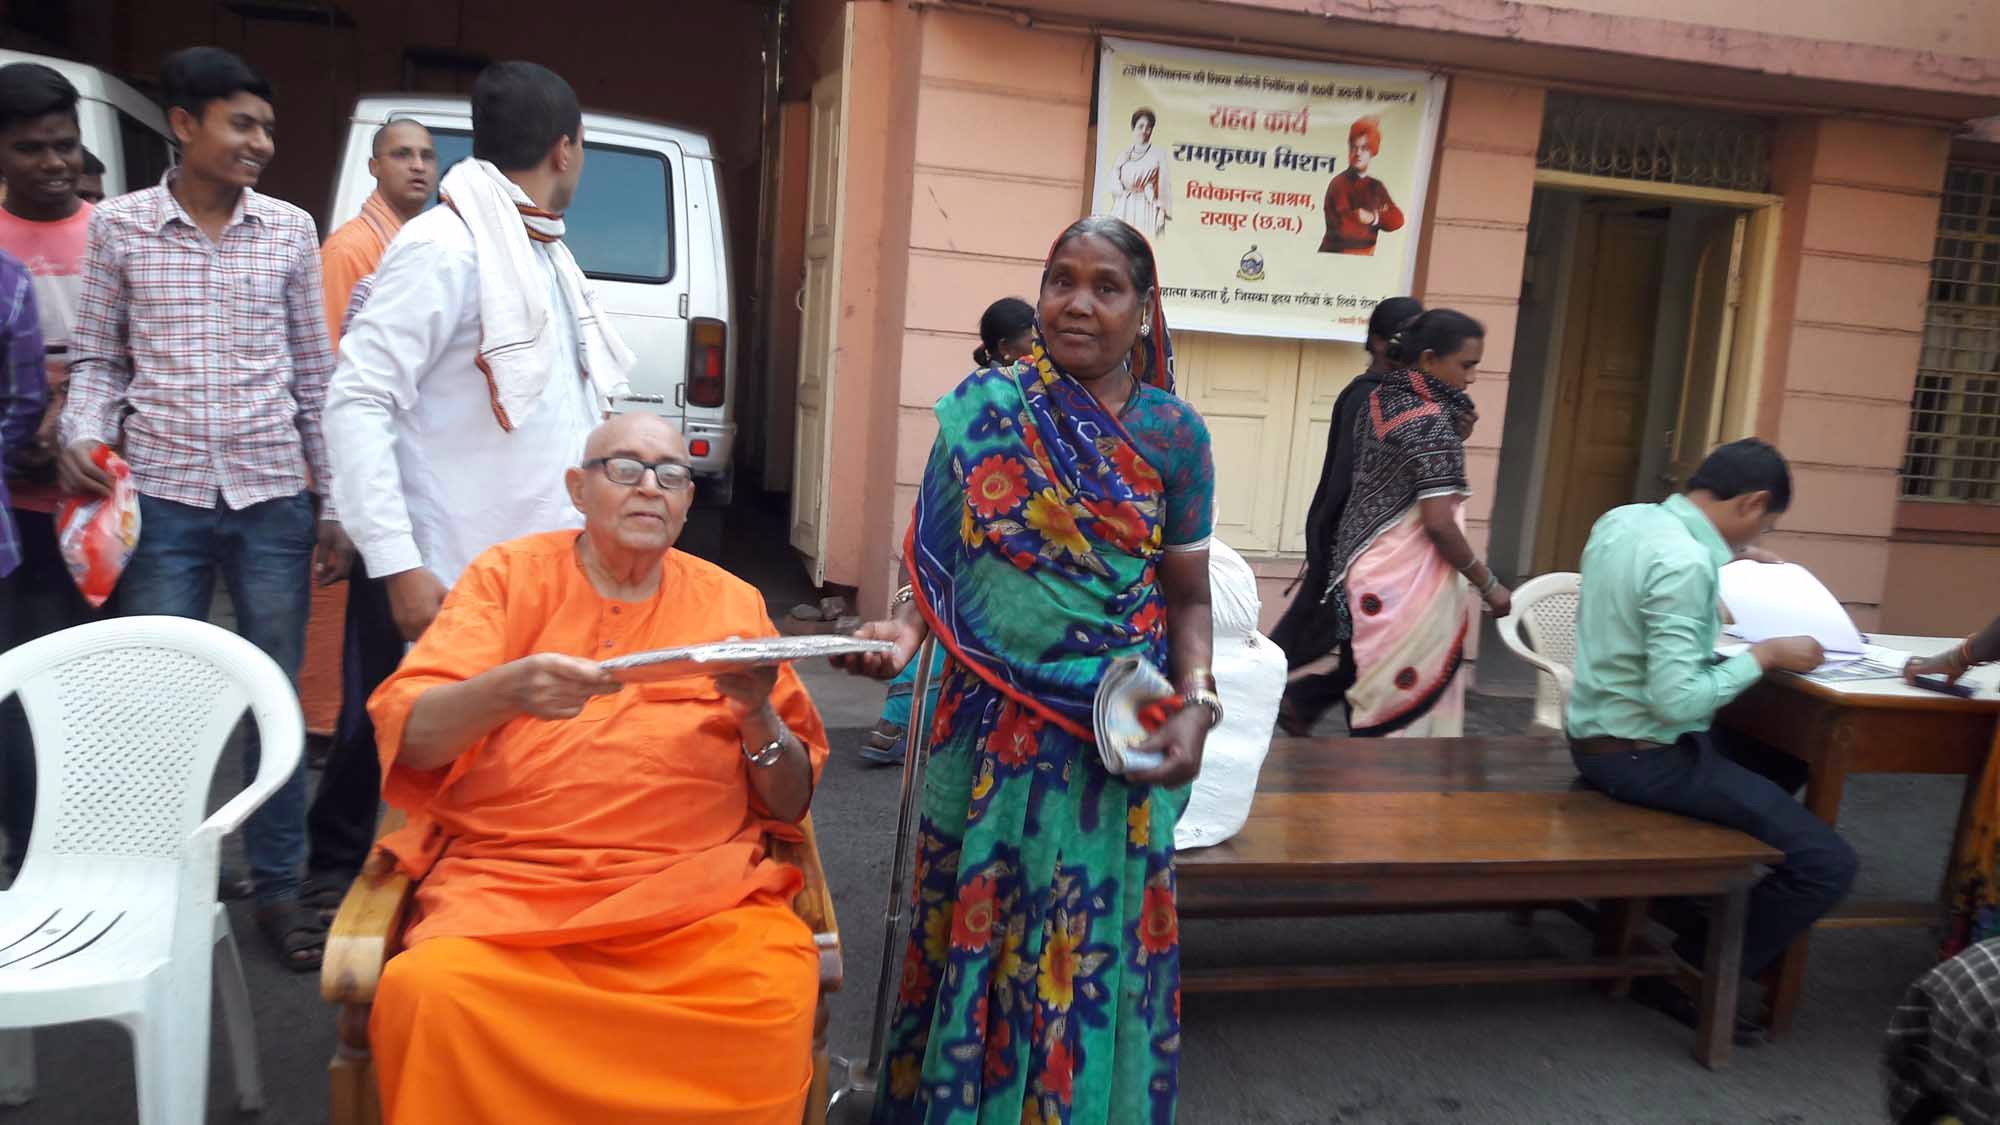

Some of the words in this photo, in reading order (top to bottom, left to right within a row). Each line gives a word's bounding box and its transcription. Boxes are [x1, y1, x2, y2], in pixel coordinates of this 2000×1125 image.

[1209, 105, 1257, 132] राहत
[1264, 104, 1310, 136] कार्य
[1172, 143, 1267, 171] रामकृष्ण
[1274, 145, 1337, 174] मिशन
[1186, 180, 1263, 204] विवेकानन्द
[1267, 191, 1316, 212] आश्रम,
[1200, 211, 1248, 232] रायपुर
[1252, 212, 1303, 235] (छ.ग.)
[1160, 286, 1187, 299] हात्मा
